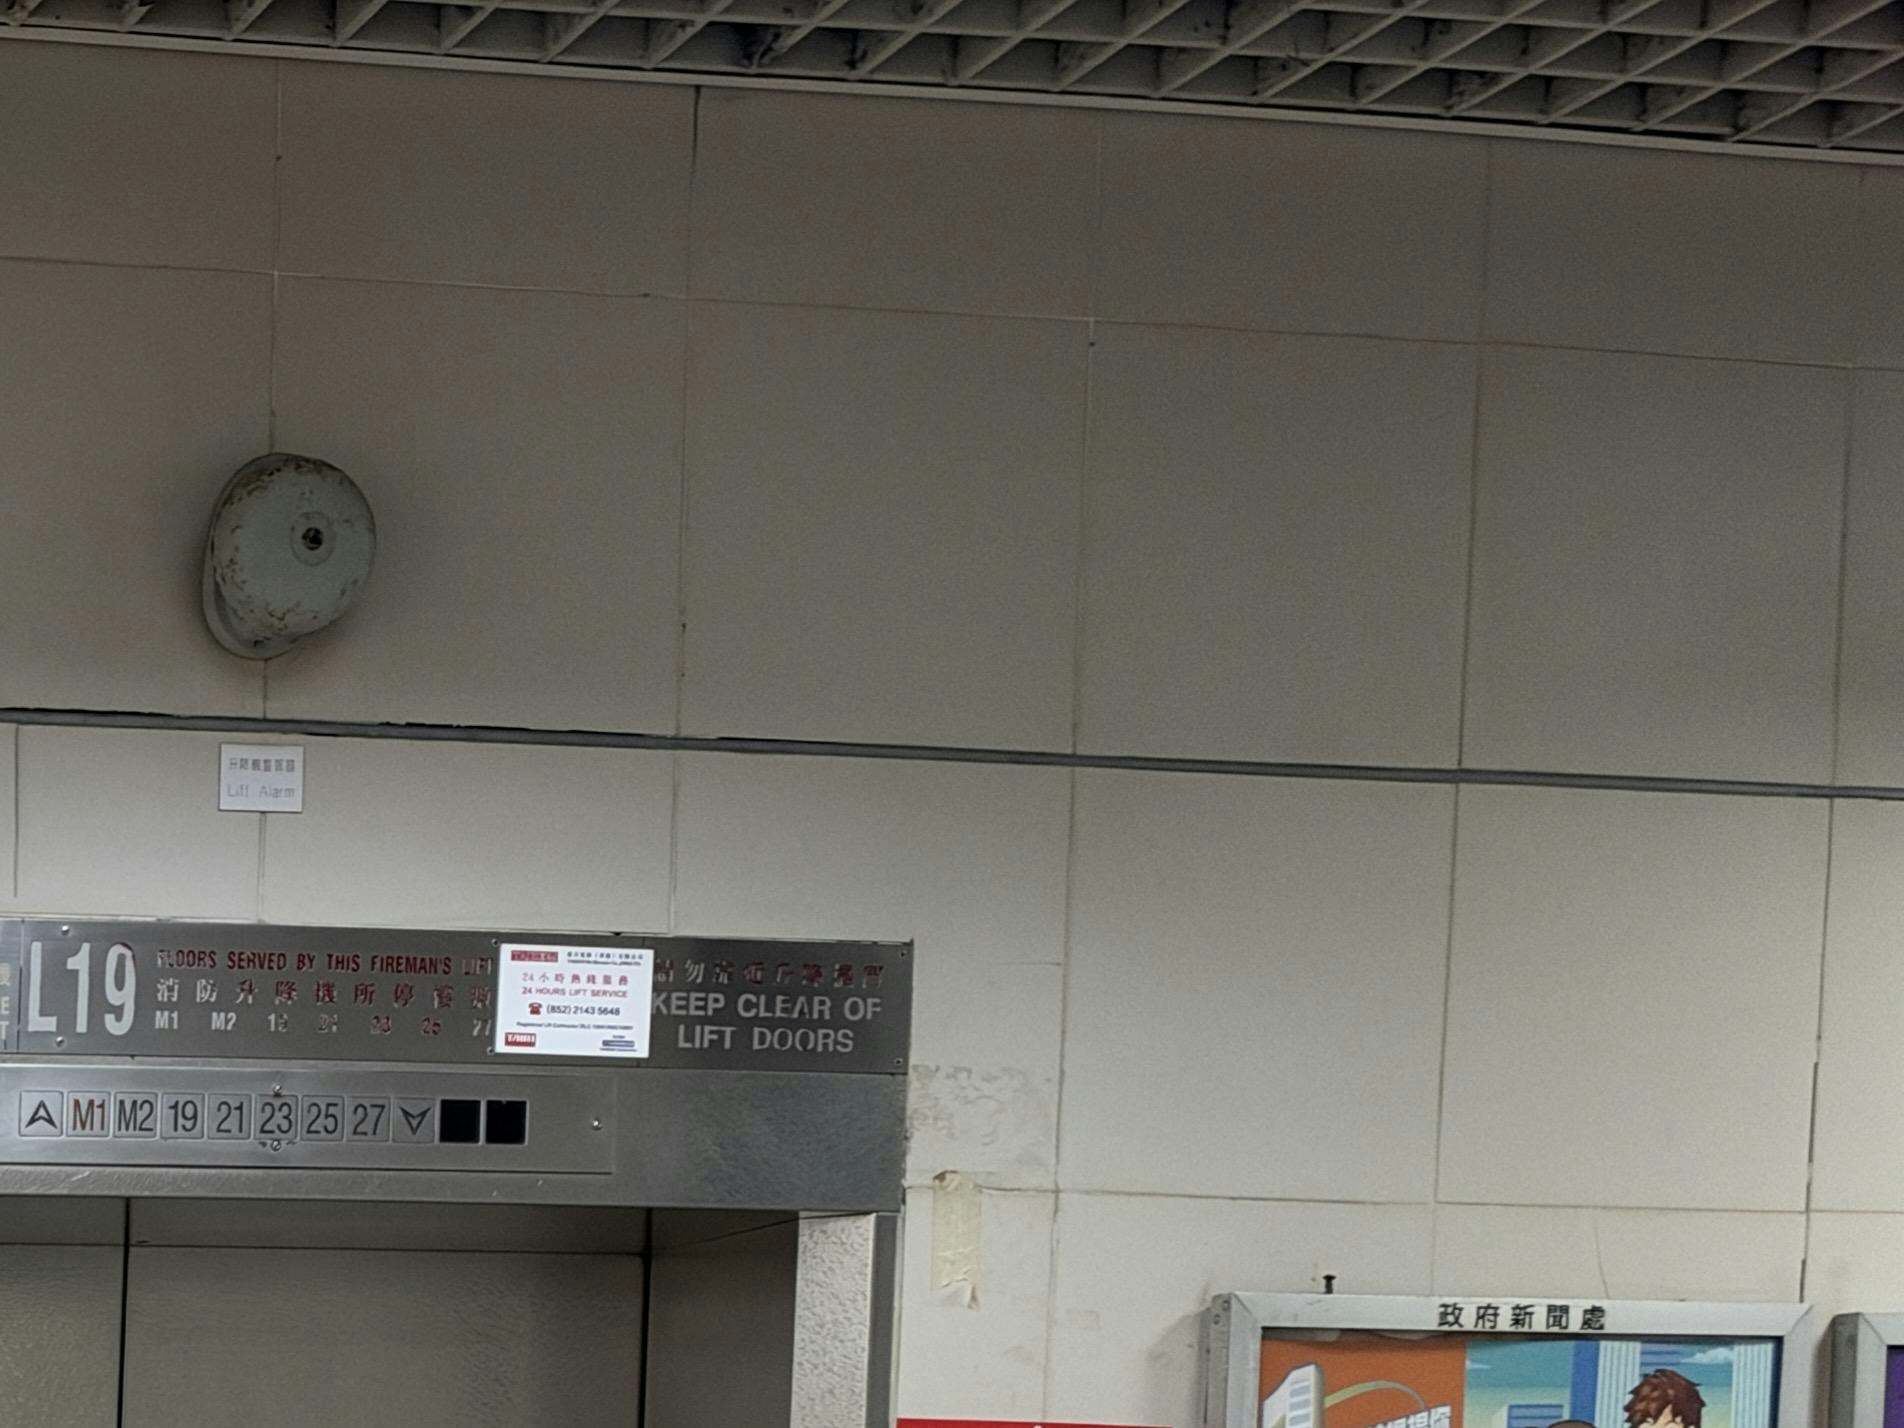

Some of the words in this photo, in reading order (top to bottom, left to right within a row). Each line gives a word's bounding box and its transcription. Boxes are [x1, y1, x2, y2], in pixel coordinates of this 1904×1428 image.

[27, 941, 137, 1036] L19
[652, 992, 725, 1016] KEEP
[737, 994, 832, 1019] CLEAR
[844, 997, 882, 1021] OF
[678, 1024, 736, 1049] LIFT
[753, 1027, 854, 1052] DOORS
[72, 1098, 106, 1131] M1
[117, 1099, 154, 1132] M2
[168, 1100, 198, 1133] 19
[216, 1101, 243, 1134] 21
[259, 1102, 293, 1134] 23
[306, 1102, 339, 1135] 25
[352, 1103, 386, 1136] 27
[1437, 1303, 1607, 1331] 政府新聞處
